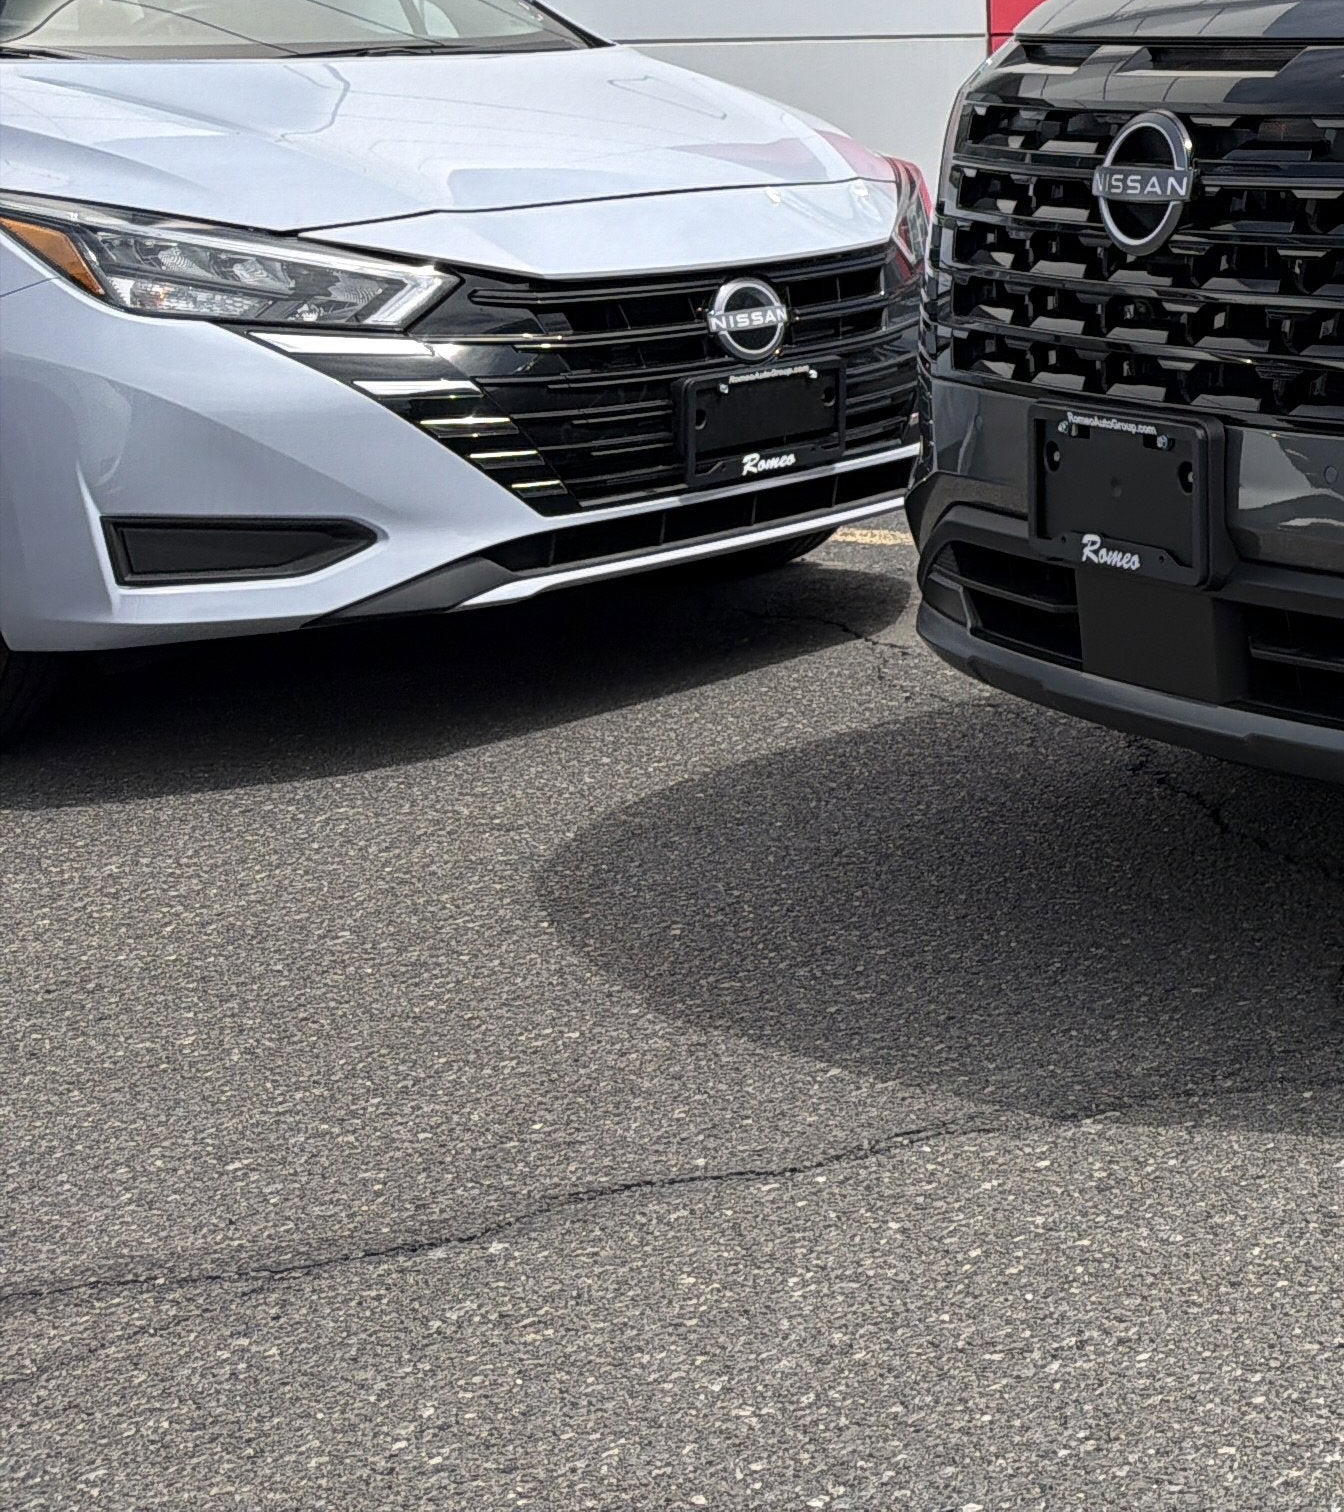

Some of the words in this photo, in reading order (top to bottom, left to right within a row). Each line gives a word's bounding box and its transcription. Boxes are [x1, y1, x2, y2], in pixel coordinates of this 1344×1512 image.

[1094, 172, 1188, 197] NISSAN
[710, 304, 788, 331] NISSAN
[1066, 411, 1158, 435] RomeoAutoGroup.com
[741, 453, 796, 476] Romeo
[1081, 534, 1141, 570] Romeo
